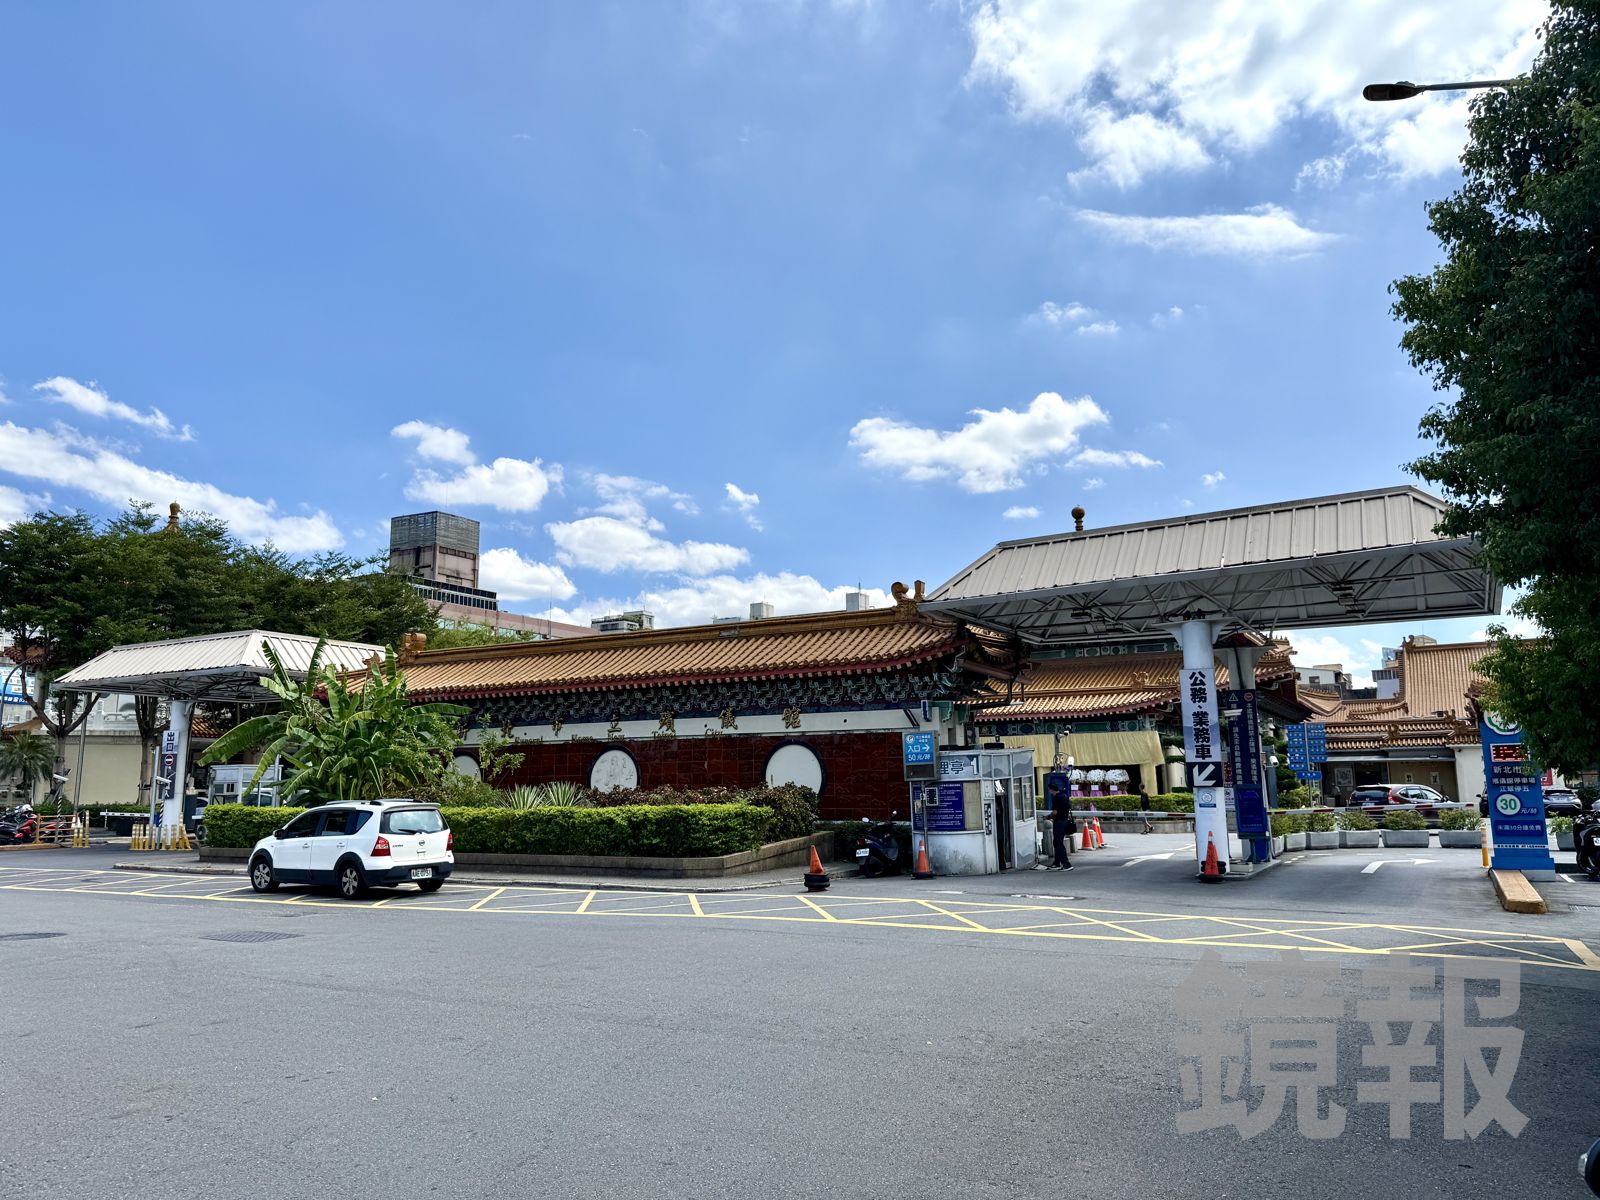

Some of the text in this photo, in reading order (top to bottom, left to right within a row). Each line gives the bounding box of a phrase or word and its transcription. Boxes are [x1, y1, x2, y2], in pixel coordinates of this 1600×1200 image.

[1189, 671, 1212, 760] 公務、業務車
[704, 727, 725, 740] City
[166, 731, 175, 752] 出口
[907, 744, 921, 752] 入口
[1493, 765, 1533, 775] 新北市
[1500, 798, 1517, 811] 30
